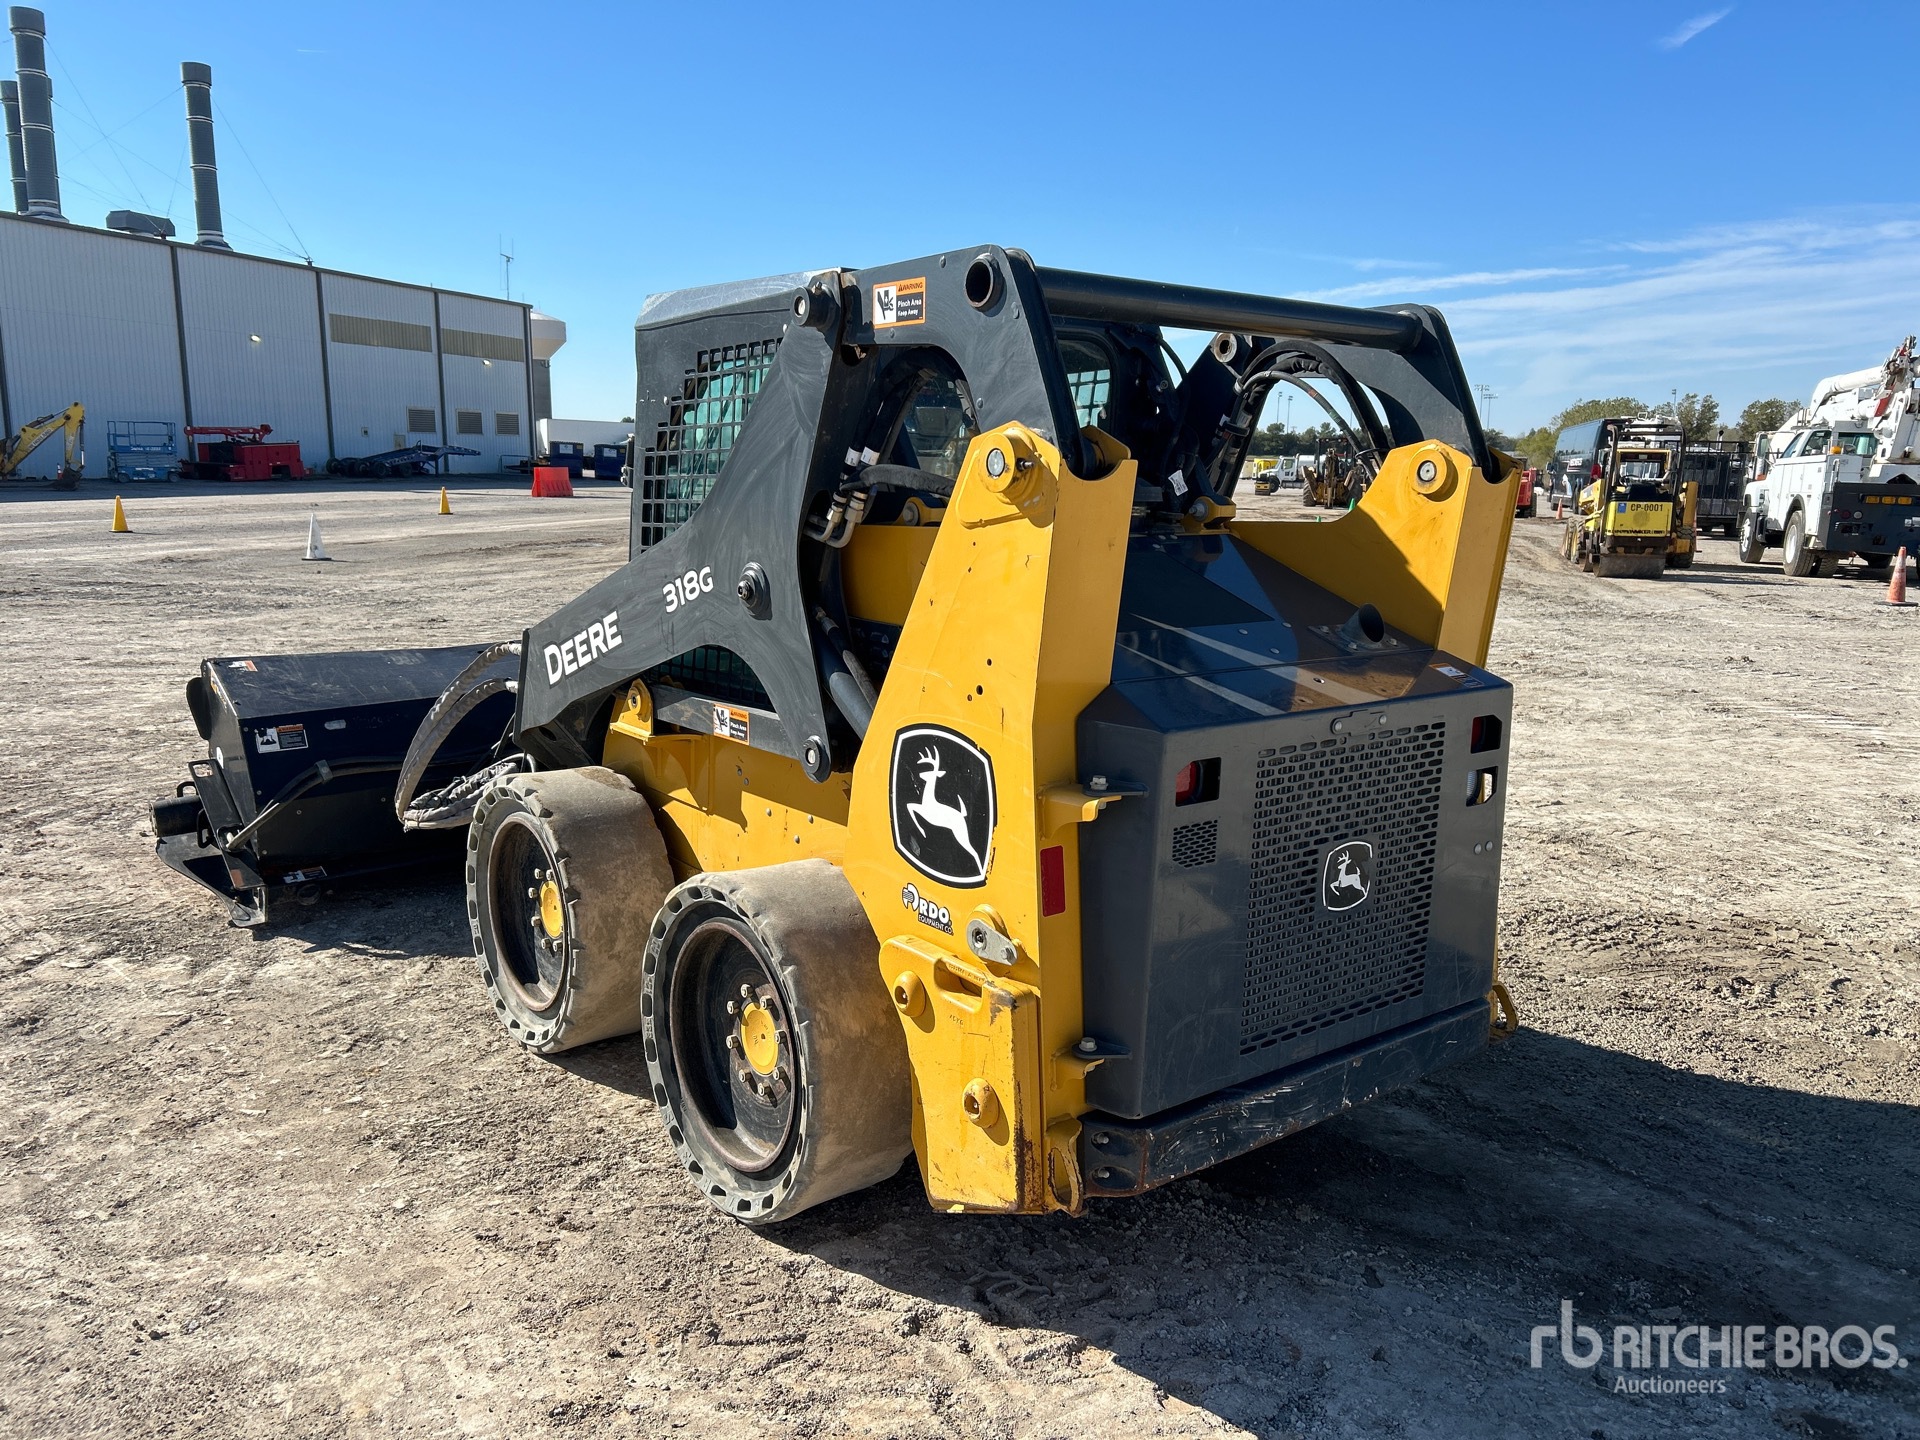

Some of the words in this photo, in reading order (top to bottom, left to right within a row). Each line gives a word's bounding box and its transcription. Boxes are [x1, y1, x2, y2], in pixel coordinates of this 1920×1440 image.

[902, 282, 923, 291] WARNING
[898, 299, 910, 308] Pinch
[911, 298, 922, 307] Area
[1630, 503, 1664, 512] CP-0001
[662, 566, 714, 613] 318G
[543, 610, 623, 685] DEERE
[918, 914, 944, 931] EQUIPMENT
